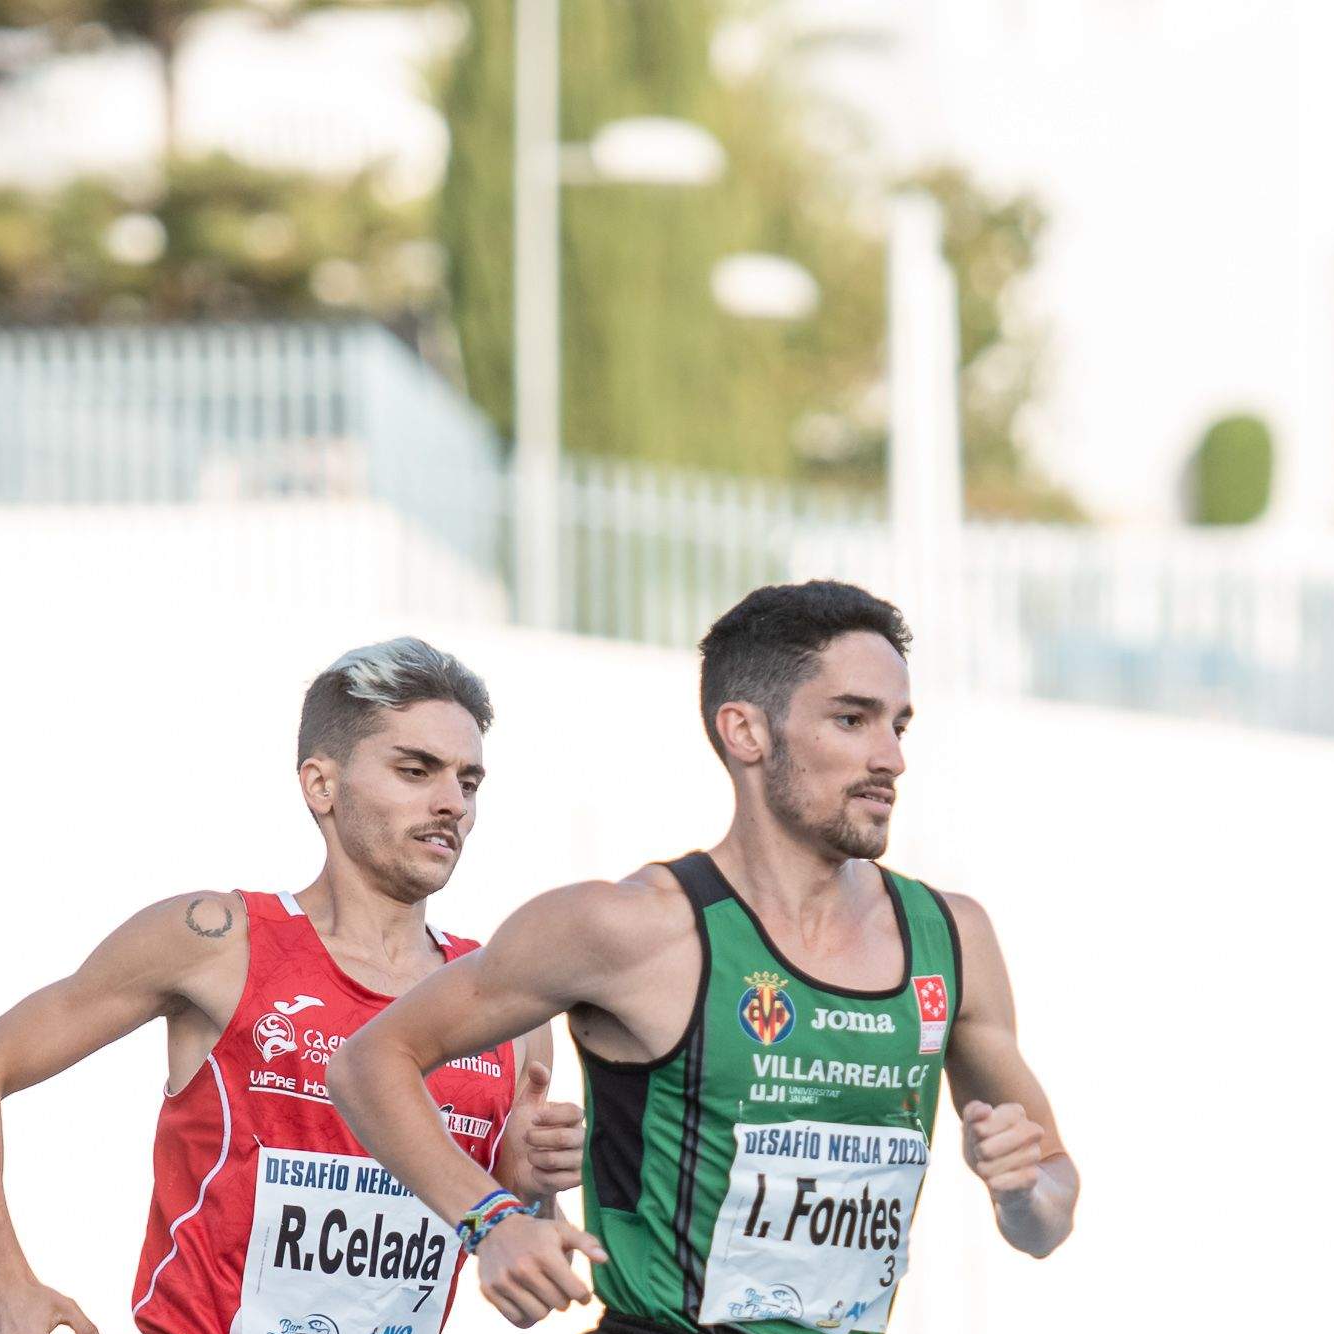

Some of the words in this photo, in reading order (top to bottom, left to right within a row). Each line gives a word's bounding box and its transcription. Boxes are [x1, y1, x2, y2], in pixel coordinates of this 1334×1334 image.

[810, 1008, 895, 1033] Joma
[752, 1054, 903, 1088] VILLARREAL
[750, 1083, 785, 1102] UJI
[789, 1086, 842, 1098] UNIVERSITAT
[789, 1095, 814, 1104] JAUME
[745, 1126, 820, 1159] DESAFÍO
[828, 1134, 881, 1164] NERJA
[888, 1138, 927, 1165] 2020
[265, 1157, 350, 1191] DESAFÍO
[354, 1166, 413, 1197] NERJ
[743, 1173, 771, 1238] I.
[783, 1177, 901, 1250] Fontes
[273, 1204, 446, 1281] R.Celada
[879, 1255, 896, 1287] 3
[412, 1285, 434, 1313] 7
[745, 1288, 765, 1304] Bar
[279, 1318, 304, 1334] Bar
